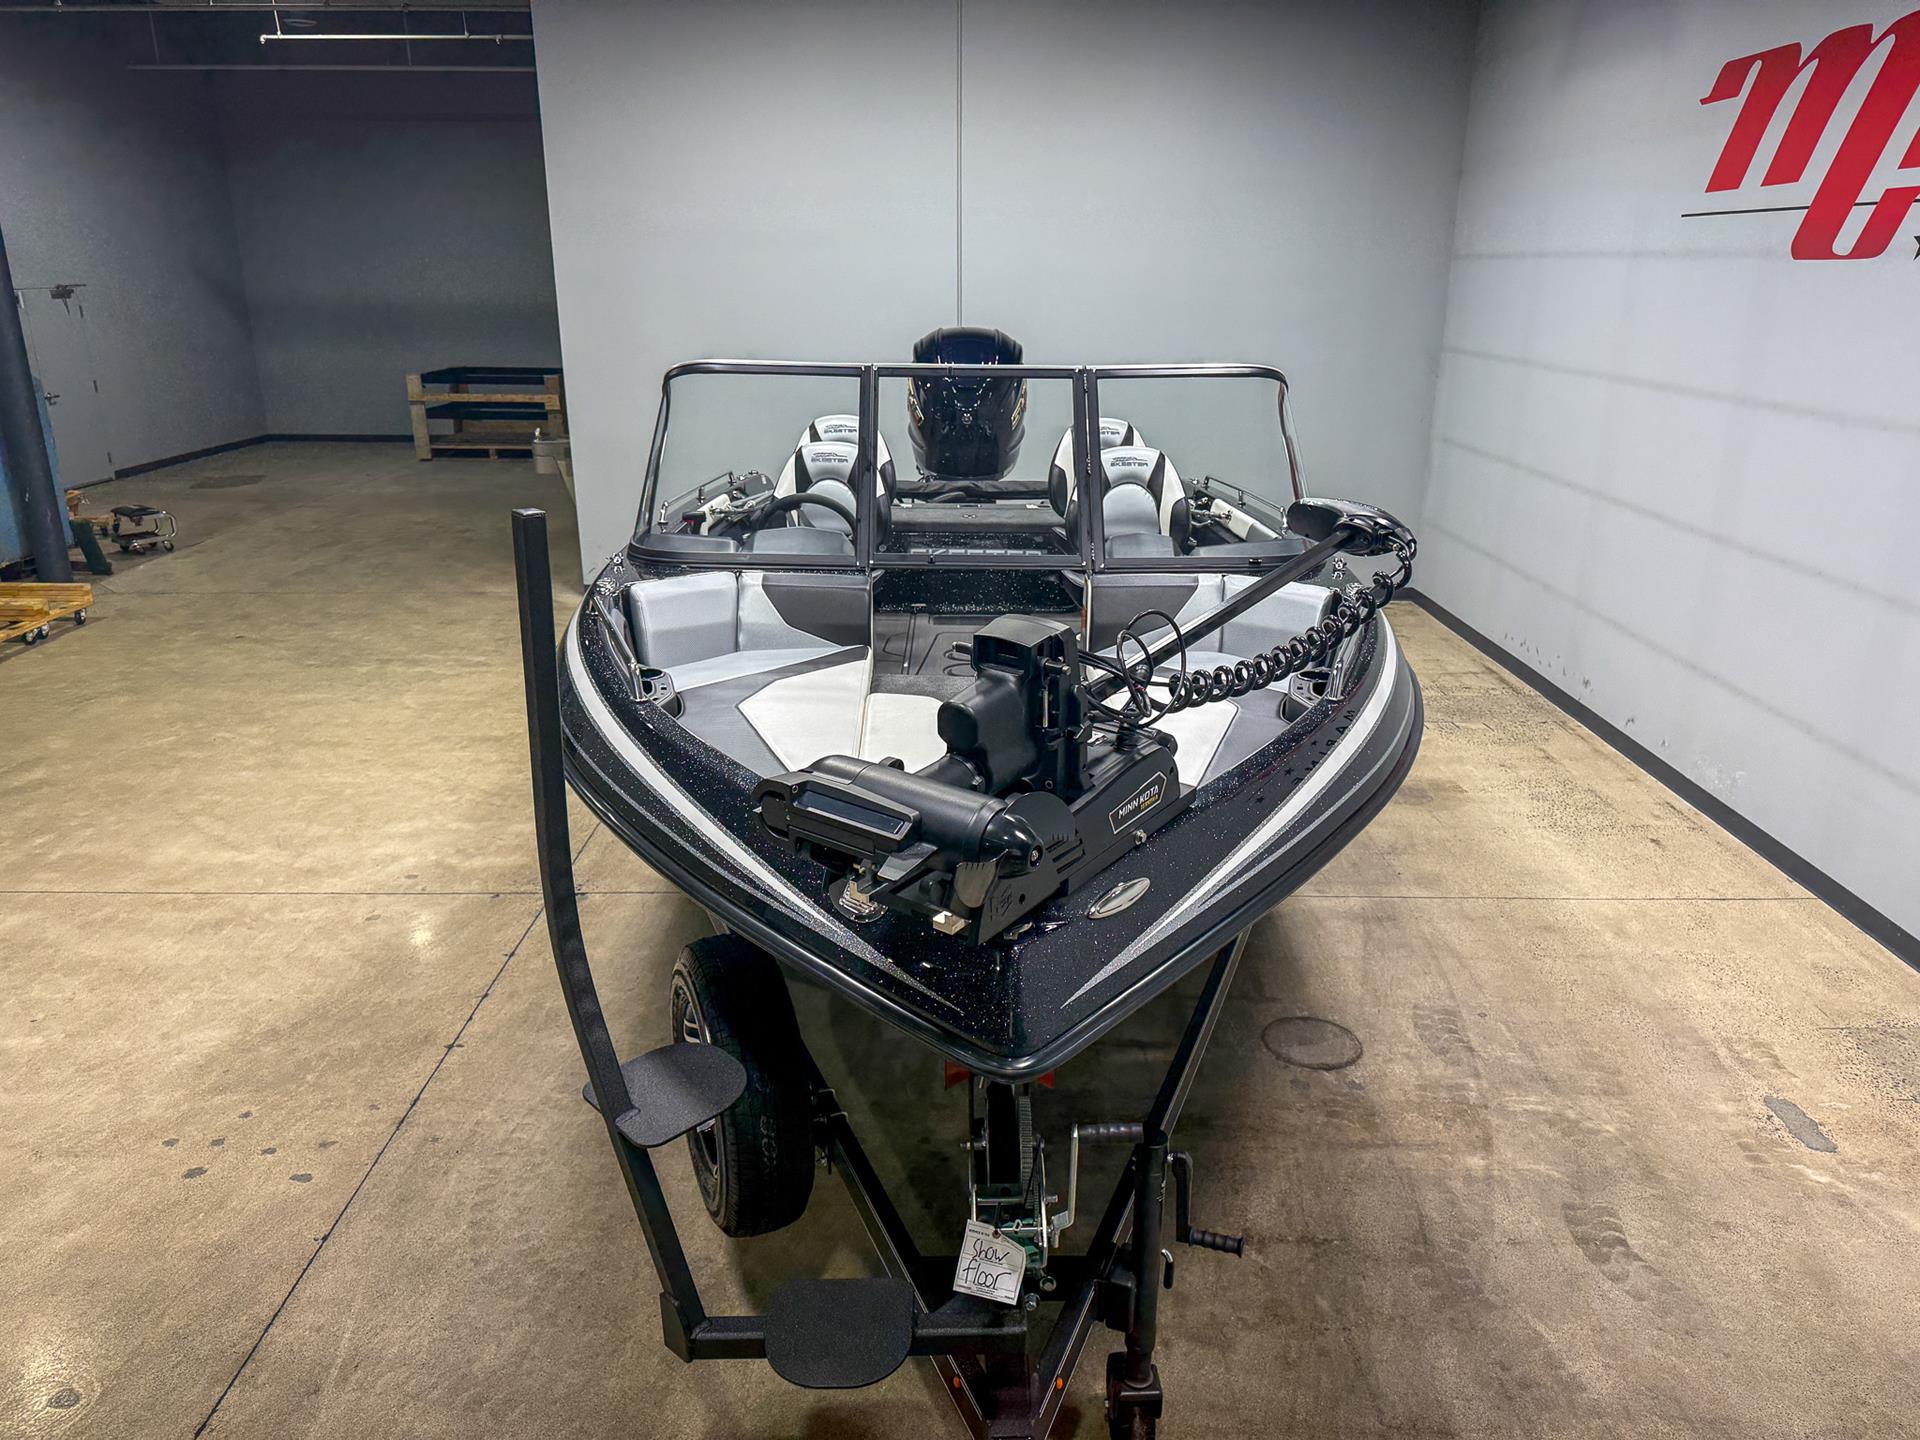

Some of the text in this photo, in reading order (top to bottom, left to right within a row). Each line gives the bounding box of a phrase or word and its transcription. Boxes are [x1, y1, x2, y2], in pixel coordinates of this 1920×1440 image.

[1118, 797, 1139, 820] MINN
[1139, 784, 1160, 805] KOTA
[971, 1238, 1010, 1262] Show
